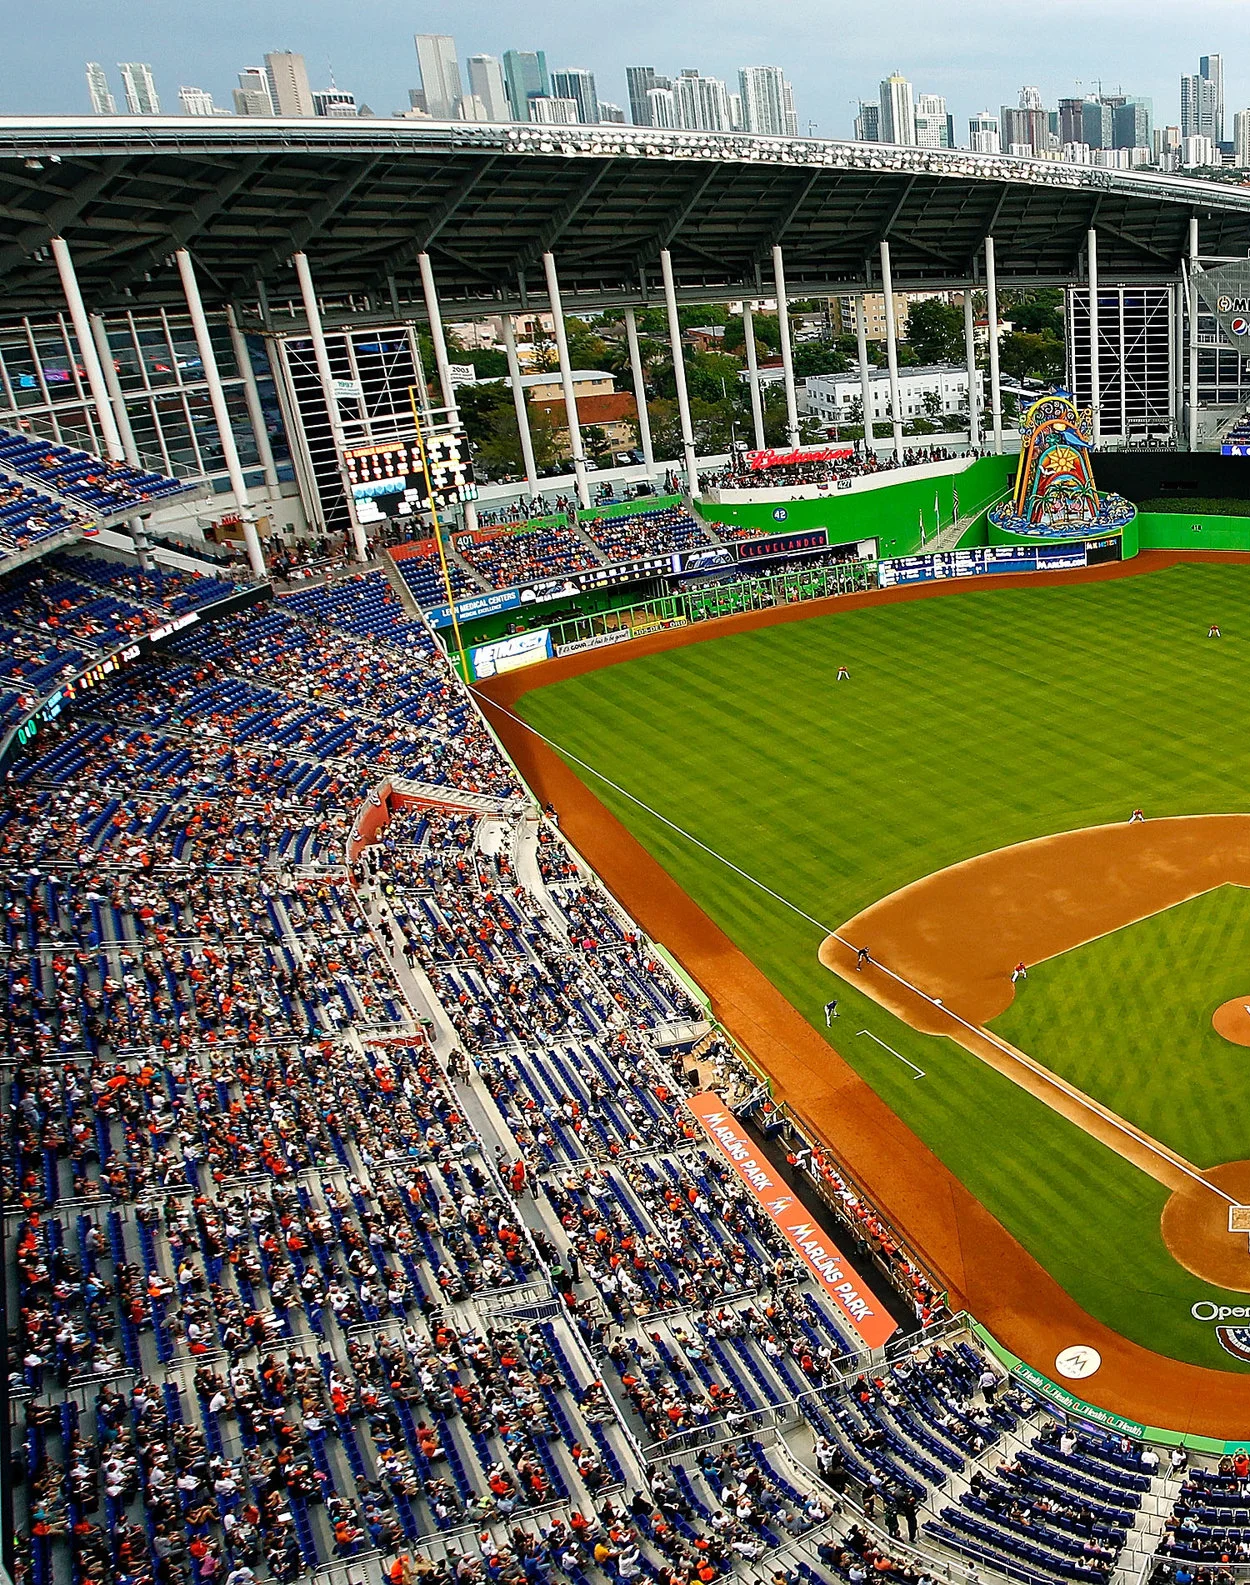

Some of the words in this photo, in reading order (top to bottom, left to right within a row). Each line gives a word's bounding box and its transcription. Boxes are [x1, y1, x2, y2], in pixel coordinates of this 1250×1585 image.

[452, 366, 470, 374] 2003
[746, 448, 854, 470] Budweiser
[838, 480, 850, 488] 427
[774, 511, 786, 519] 42
[456, 534, 474, 546] 401
[739, 535, 826, 558] CLEVELANDER
[442, 607, 460, 617] LEN
[460, 600, 488, 612] MEDICAL
[488, 592, 516, 606] CENTERS
[460, 610, 477, 619] MEDICAL
[570, 642, 587, 652] GOYA
[701, 1111, 750, 1162] MARLINS
[739, 1156, 774, 1192] PARK
[786, 1222, 844, 1284] MARLINS
[834, 1282, 875, 1322] PARK
